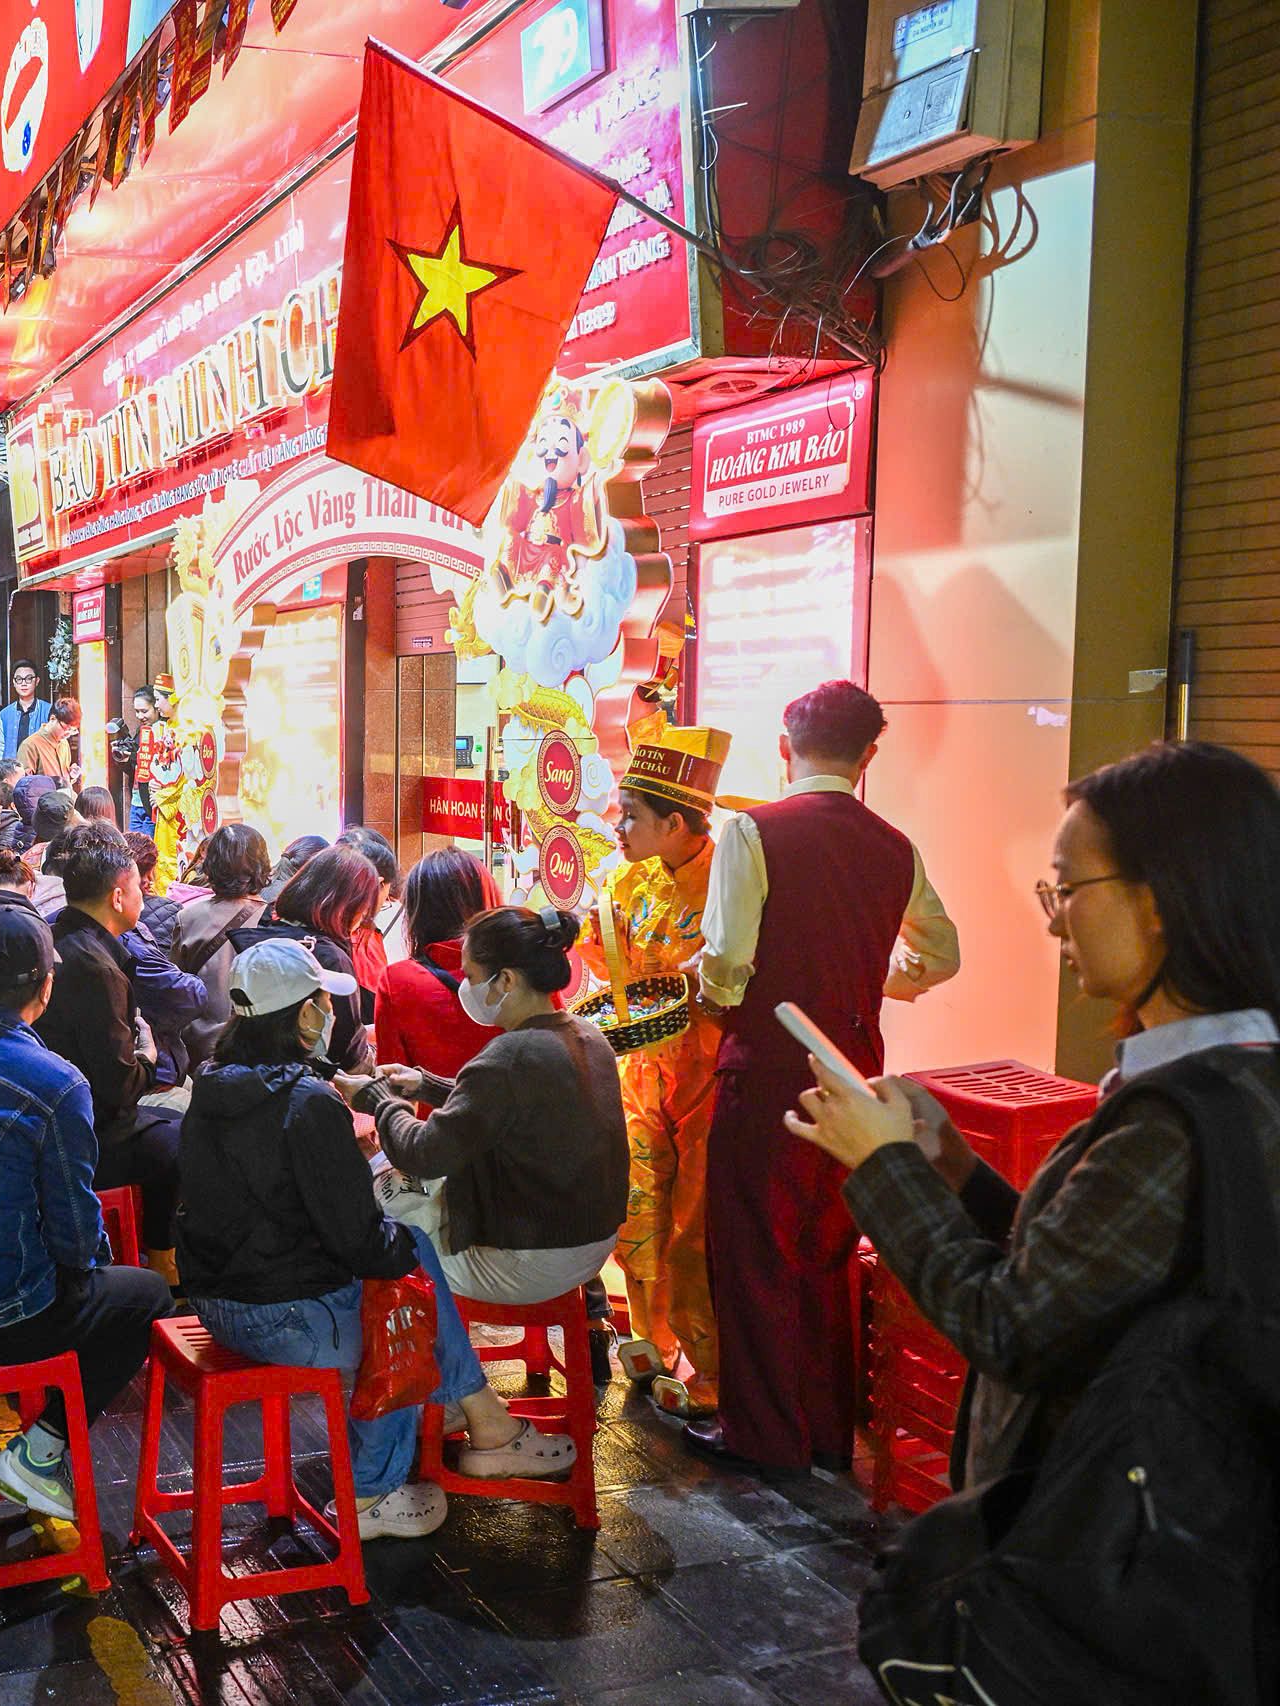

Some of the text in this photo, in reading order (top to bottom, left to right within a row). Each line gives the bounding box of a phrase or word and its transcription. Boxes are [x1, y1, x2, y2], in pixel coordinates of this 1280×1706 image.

[280, 263, 343, 396] CH
[747, 418, 806, 445] BTMC 1989
[709, 424, 845, 484] HOÀNG KIM BẢO
[719, 474, 830, 507] PURE GOLD JEWELRY
[233, 529, 271, 585] Rước
[273, 509, 304, 551] Lộc
[307, 488, 357, 530] Vàng
[641, 761, 671, 775] CHÂU
[647, 750, 665, 761] TÍN
[544, 761, 574, 790] Sang
[430, 796, 449, 815] HÂN
[450, 801, 478, 818] HOAN
[550, 852, 575, 882] Quý
